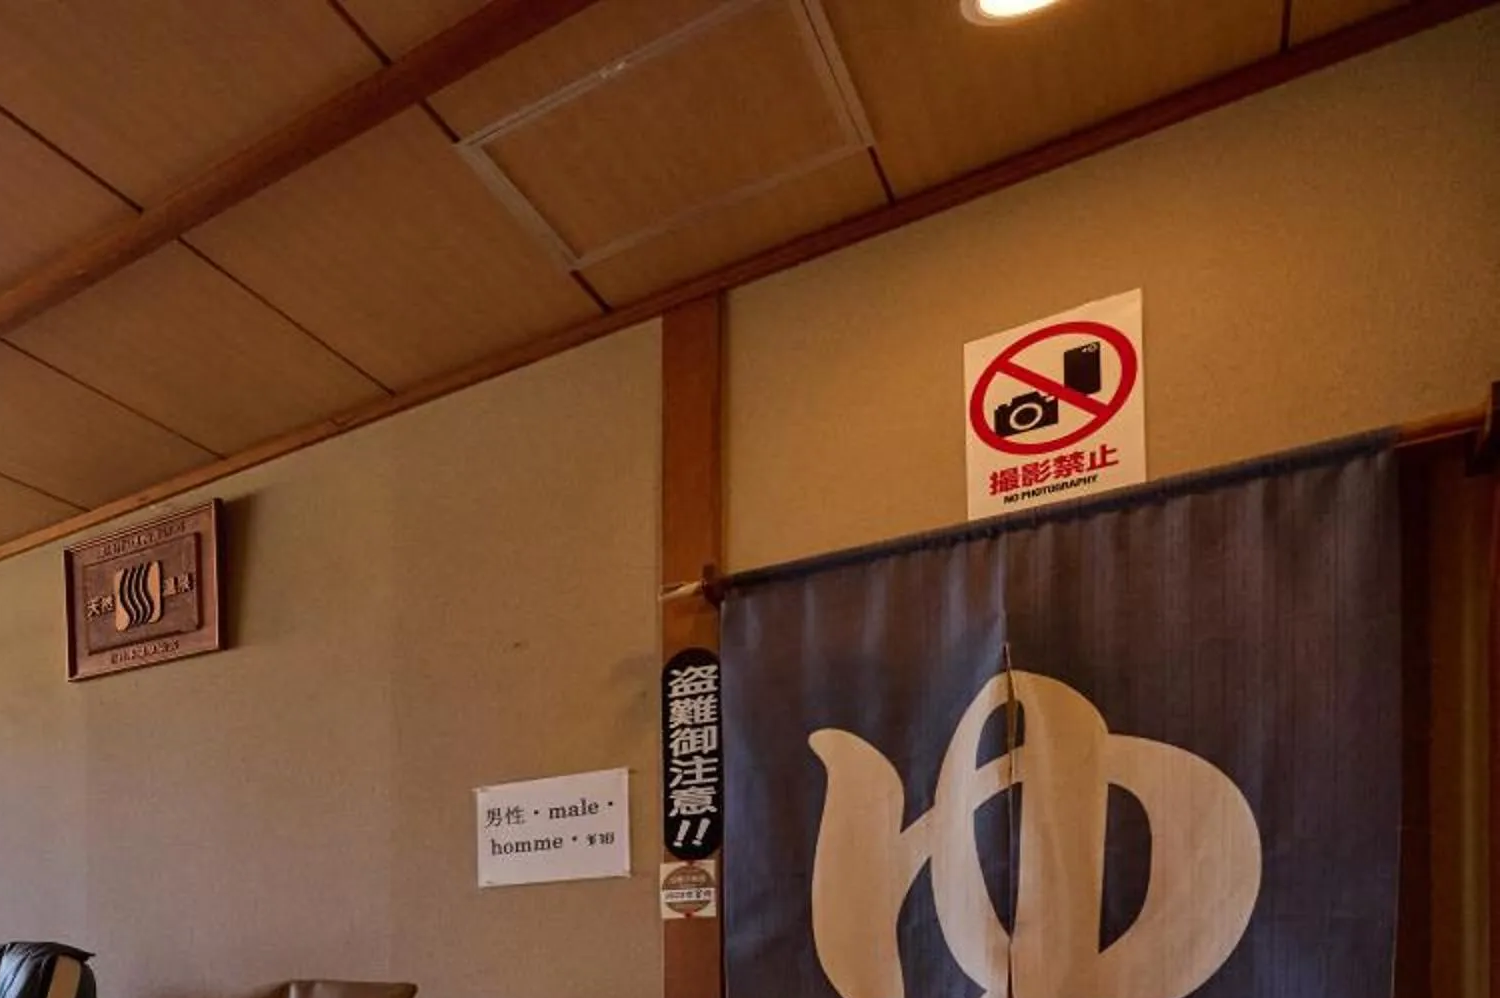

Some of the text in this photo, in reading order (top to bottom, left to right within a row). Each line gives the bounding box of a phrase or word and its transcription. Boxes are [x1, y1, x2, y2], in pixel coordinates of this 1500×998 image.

[989, 444, 1119, 496] 撮影禁止
[1003, 474, 1098, 504] NO PHOTOGRAPHY
[548, 797, 600, 820] male
[491, 836, 563, 856] homme
